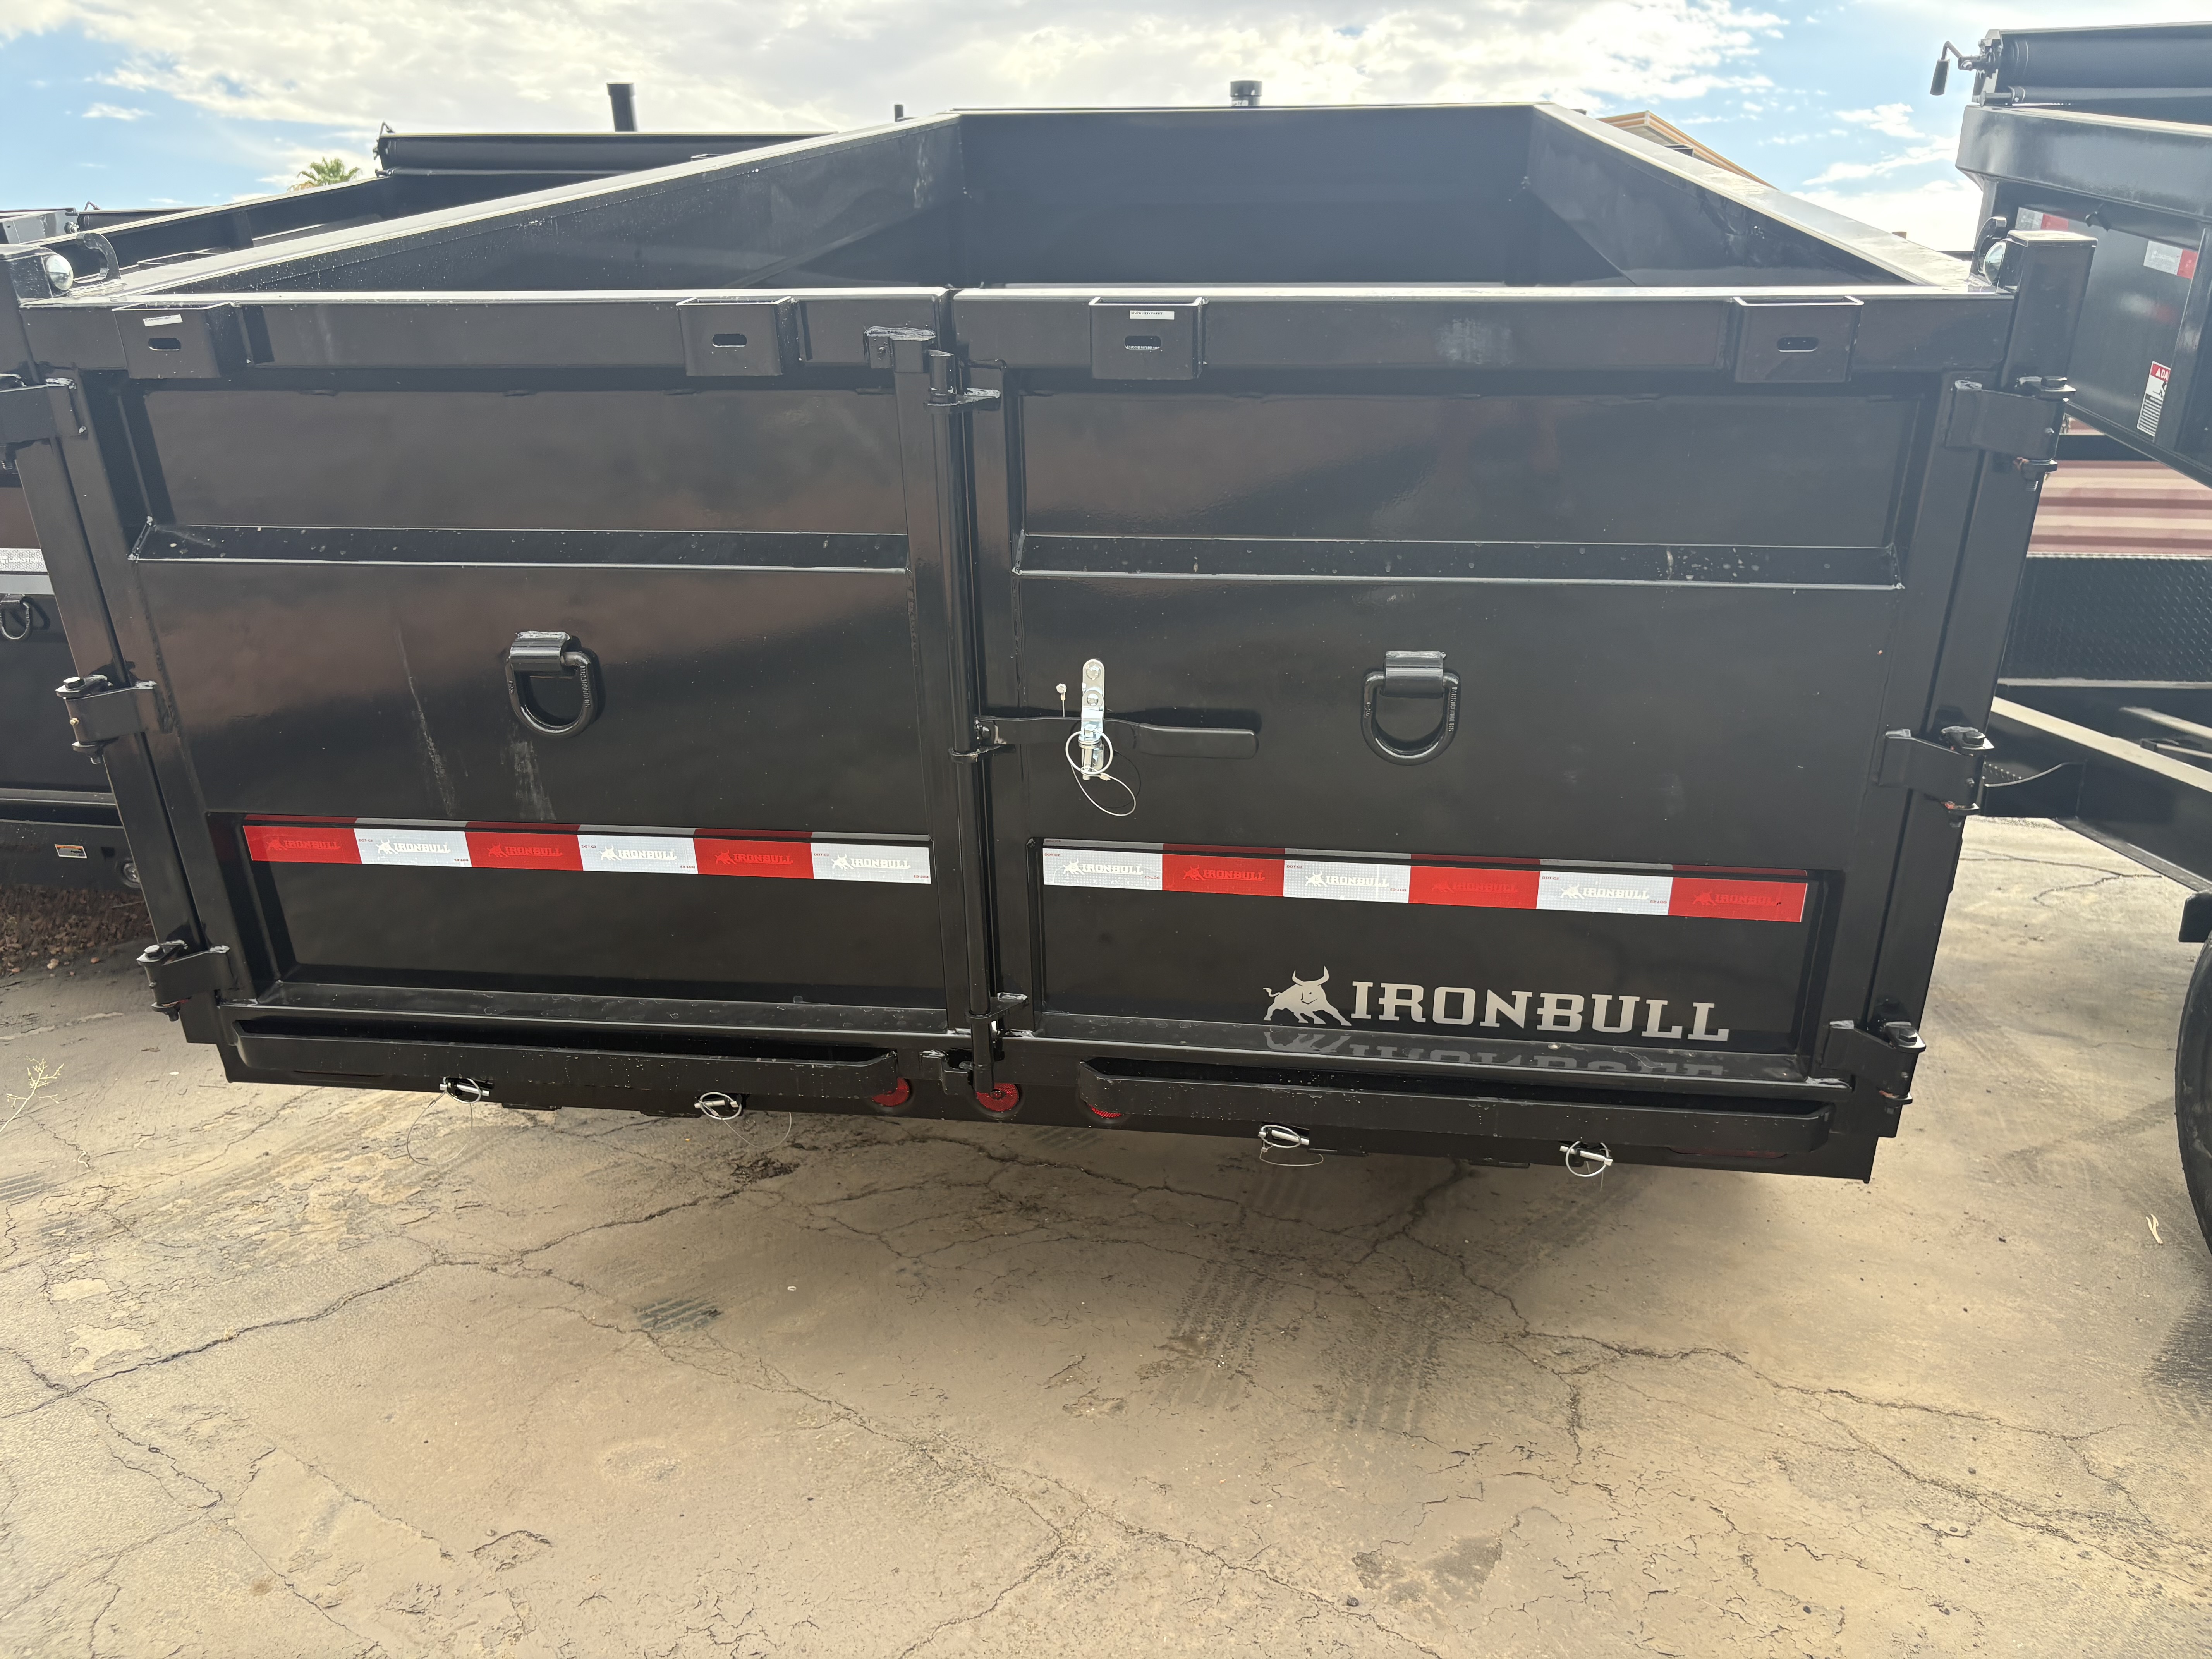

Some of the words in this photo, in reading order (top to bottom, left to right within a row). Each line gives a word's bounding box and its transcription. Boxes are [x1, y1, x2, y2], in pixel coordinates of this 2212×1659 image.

[393, 842, 451, 854] IRONBULL
[619, 849, 676, 860] IRONBULL
[734, 854, 792, 864] IRONBULL
[851, 858, 910, 869] IRONBULL
[1082, 863, 1143, 875] IRONBULL
[1203, 869, 1264, 881] IRONBULL
[1325, 875, 1388, 888] IRONBULL
[1583, 887, 1649, 900] IRONBULL
[1351, 981, 1729, 1041] IRONBULL
